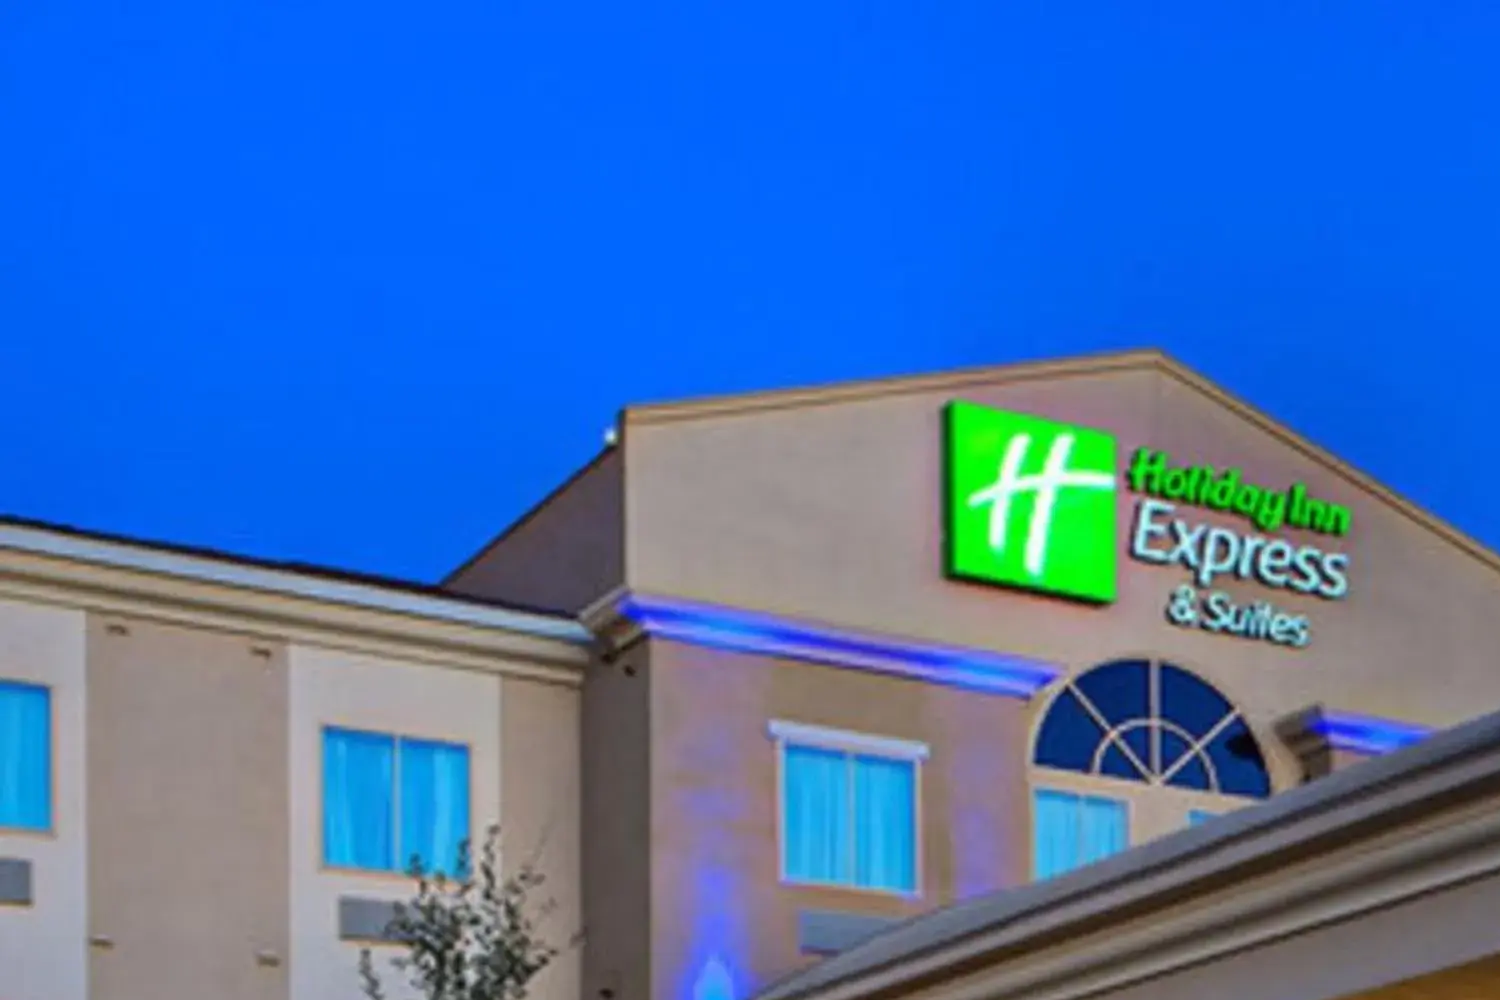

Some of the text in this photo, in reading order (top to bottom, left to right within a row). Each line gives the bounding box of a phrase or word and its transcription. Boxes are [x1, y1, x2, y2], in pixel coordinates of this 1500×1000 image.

[1129, 446, 1351, 535] Holiday Inn
[1133, 498, 1350, 598] Express
[1169, 583, 1310, 646] & Suites
